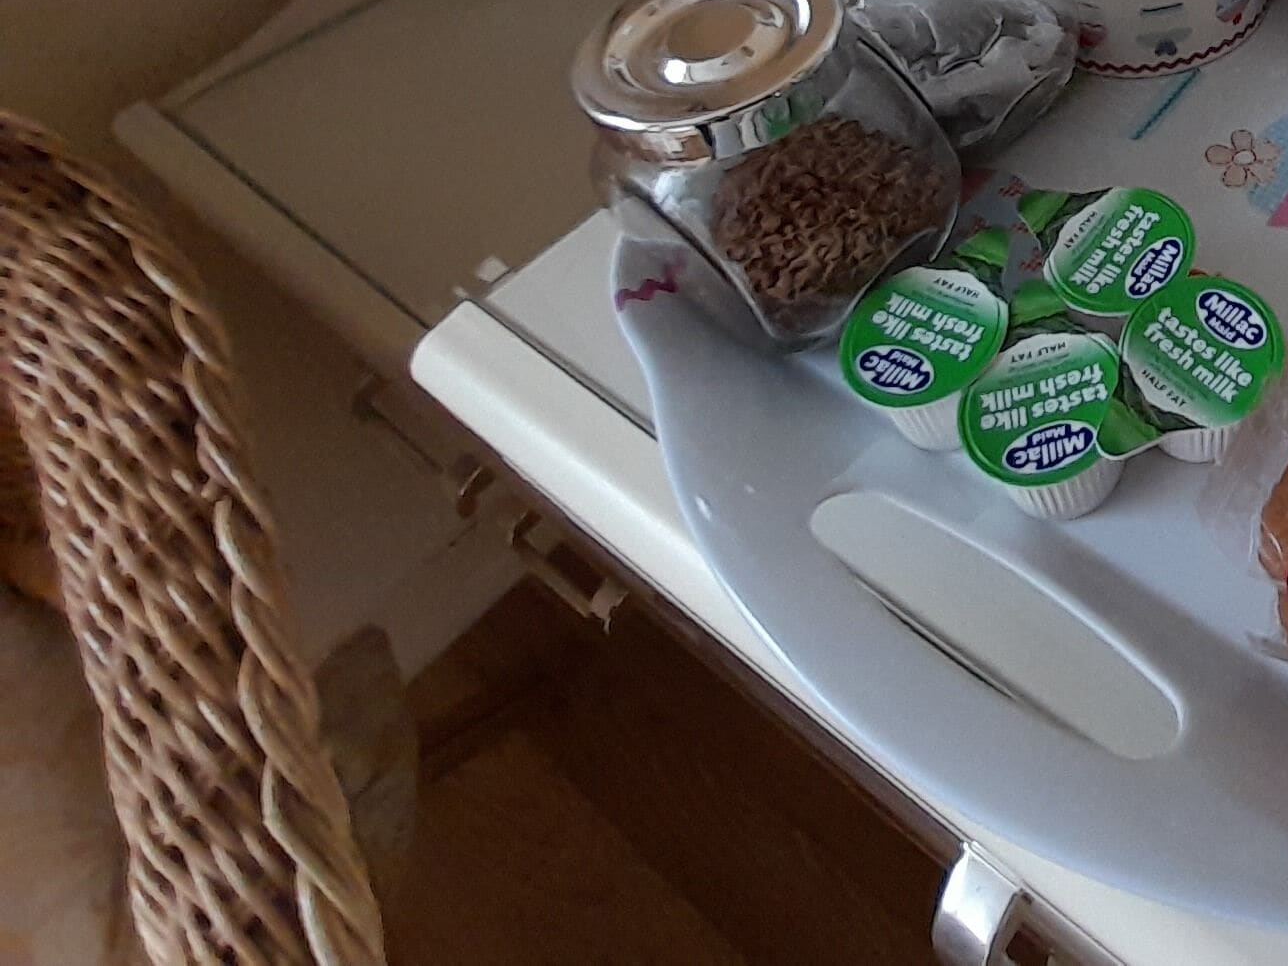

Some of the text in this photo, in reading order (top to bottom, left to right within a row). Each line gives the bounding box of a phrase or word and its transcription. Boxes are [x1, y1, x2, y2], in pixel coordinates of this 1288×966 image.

[1101, 204, 1144, 248] fresh
[1112, 212, 1161, 265] tastes
[933, 276, 955, 289] FAT
[1069, 248, 1108, 286] milk
[1086, 264, 1122, 294] like
[1134, 242, 1179, 293] Millac
[886, 292, 934, 321] milk
[955, 284, 980, 299] HALF
[932, 312, 985, 344] fresh
[1204, 294, 1260, 341] Millac
[871, 310, 974, 362] tastes like
[1011, 341, 1066, 363] HALF FAT
[1158, 306, 1217, 360] tastes
[1214, 350, 1253, 387] like
[863, 355, 926, 389] Millac
[1039, 362, 1103, 397] fresh
[1143, 322, 1194, 371] fresh
[1191, 364, 1239, 404] milk
[980, 382, 1035, 412] milk
[980, 383, 1108, 430] tastes like
[1141, 369, 1168, 391] HALF
[1166, 390, 1187, 408] FAT
[1013, 432, 1086, 467] Millac
